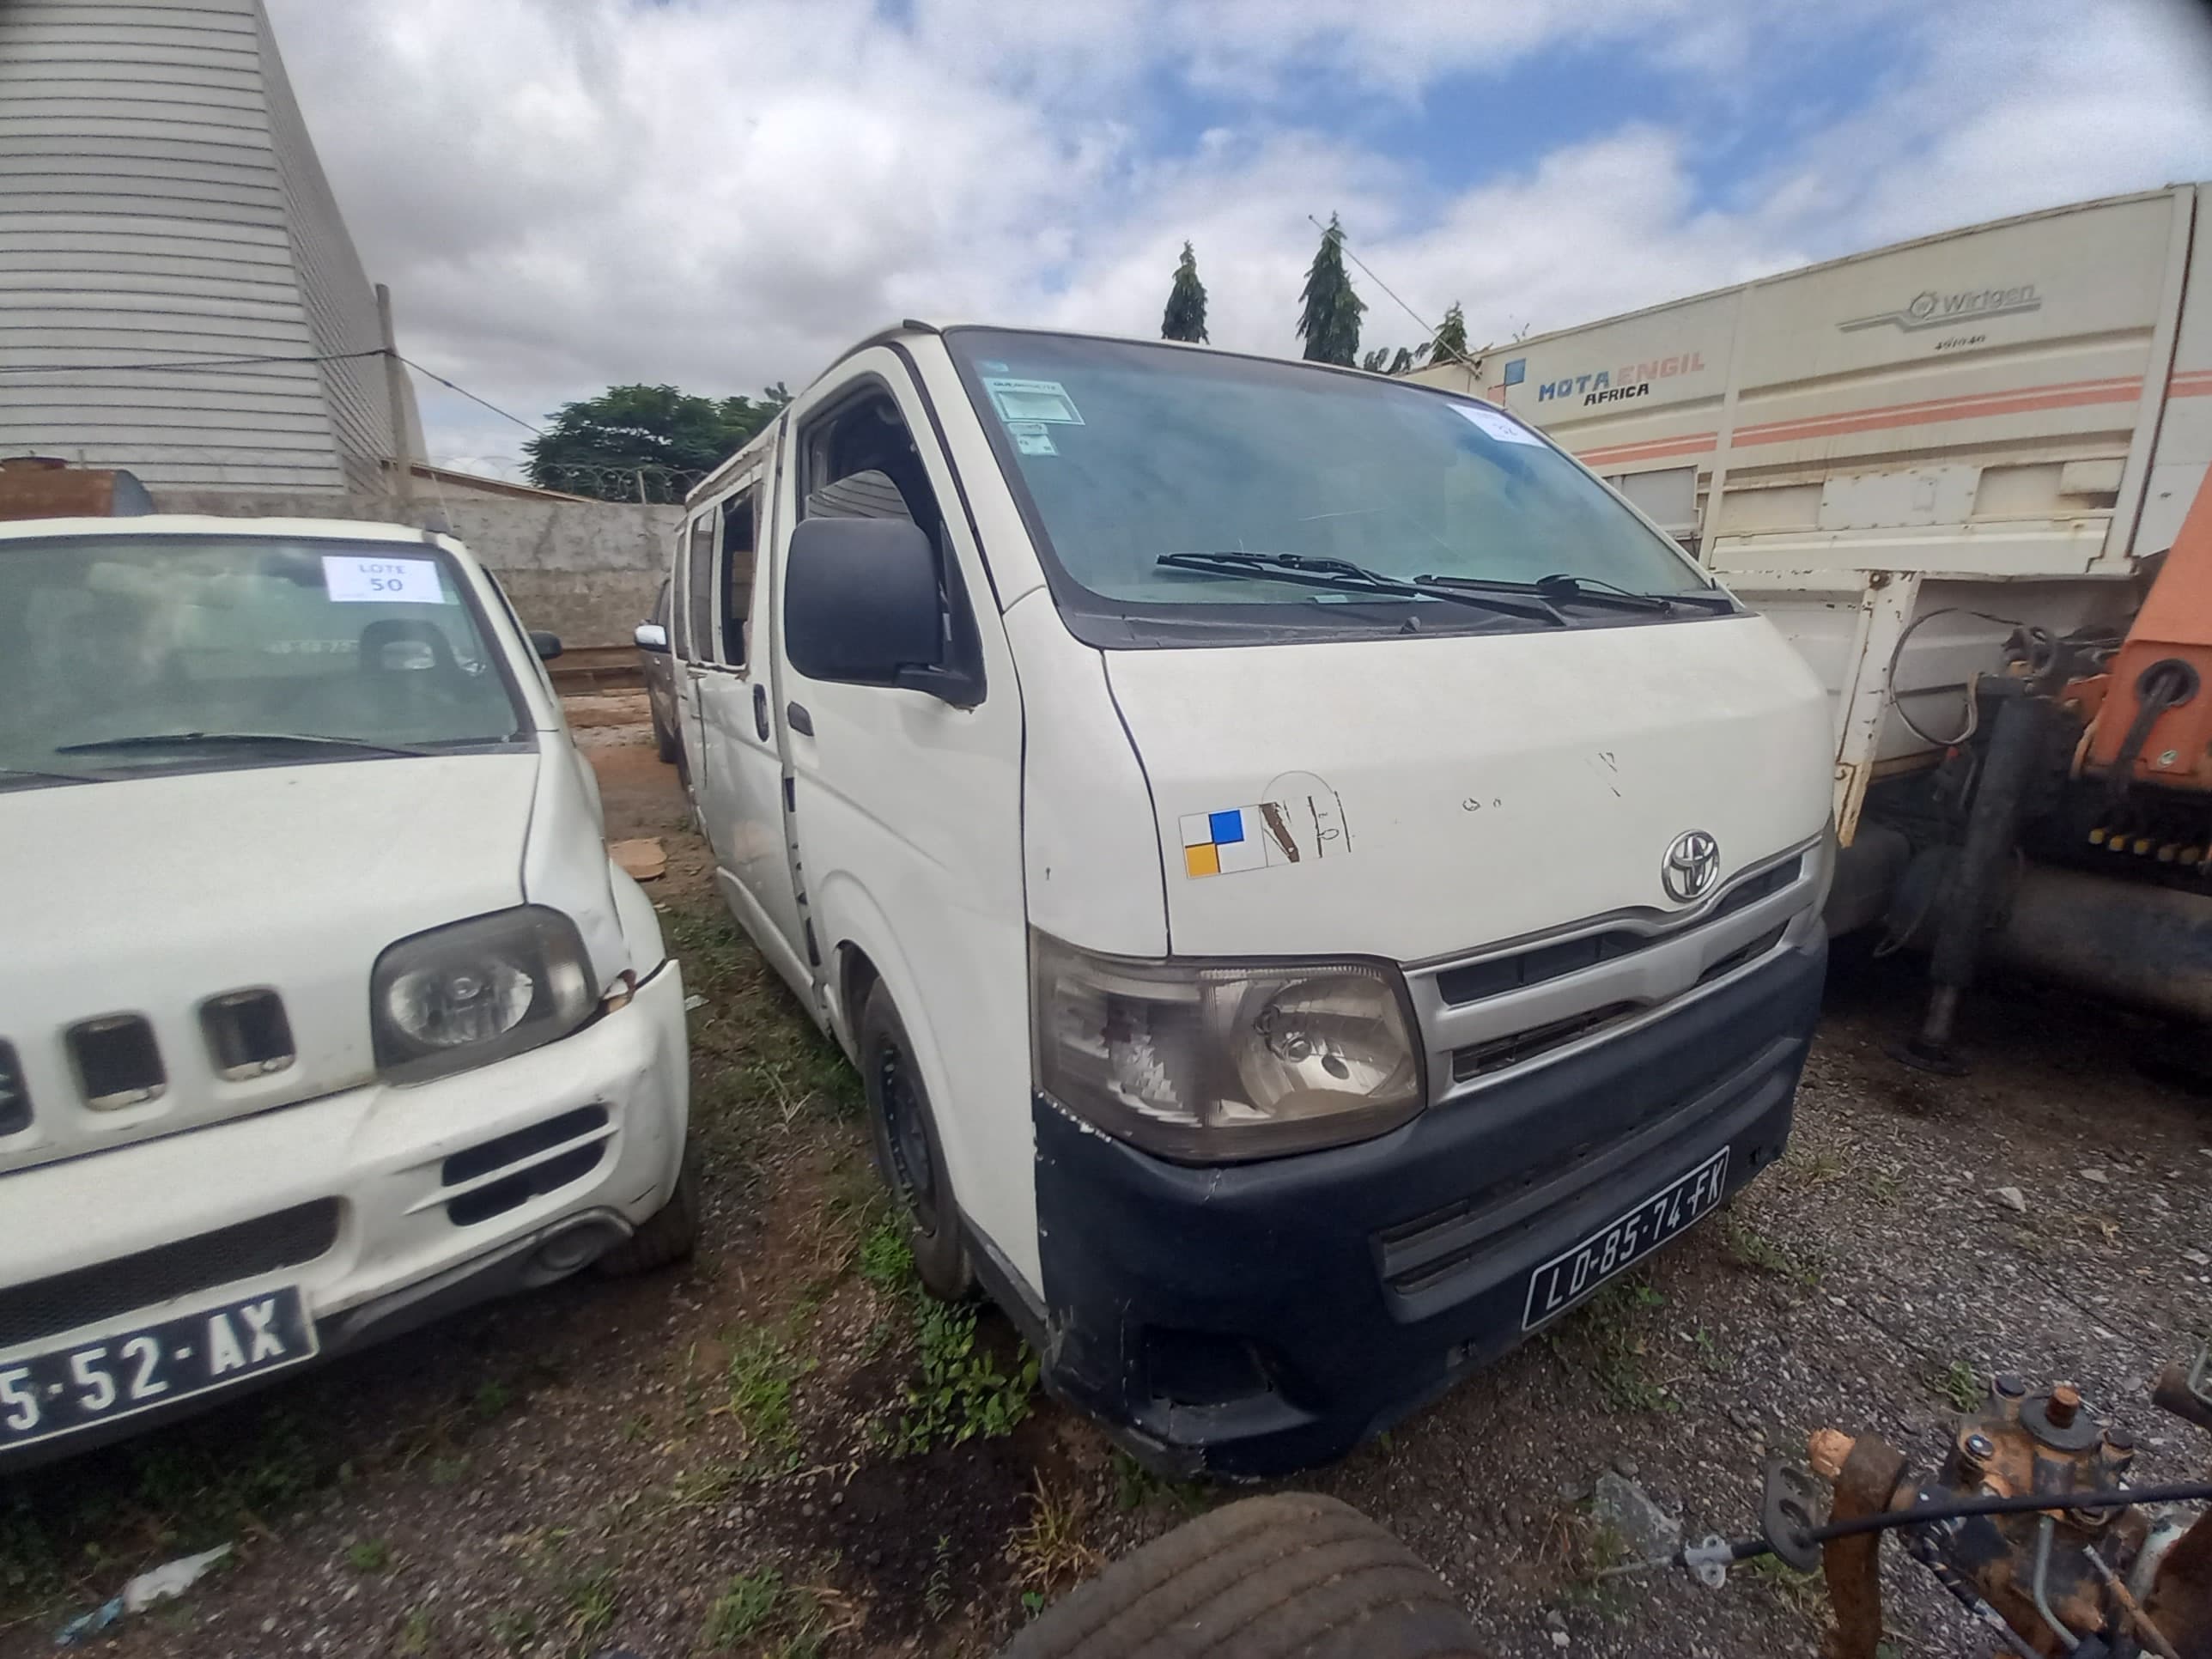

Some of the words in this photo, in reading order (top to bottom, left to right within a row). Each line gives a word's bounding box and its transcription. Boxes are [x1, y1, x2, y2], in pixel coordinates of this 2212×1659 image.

[1943, 284, 2035, 312] Wirtgen
[1538, 370, 1610, 403] MOTA
[1616, 351, 1705, 386] ENGIL
[1583, 383, 1650, 406] AFRICA
[359, 563, 406, 574] LOTE
[370, 578, 404, 592] 50
